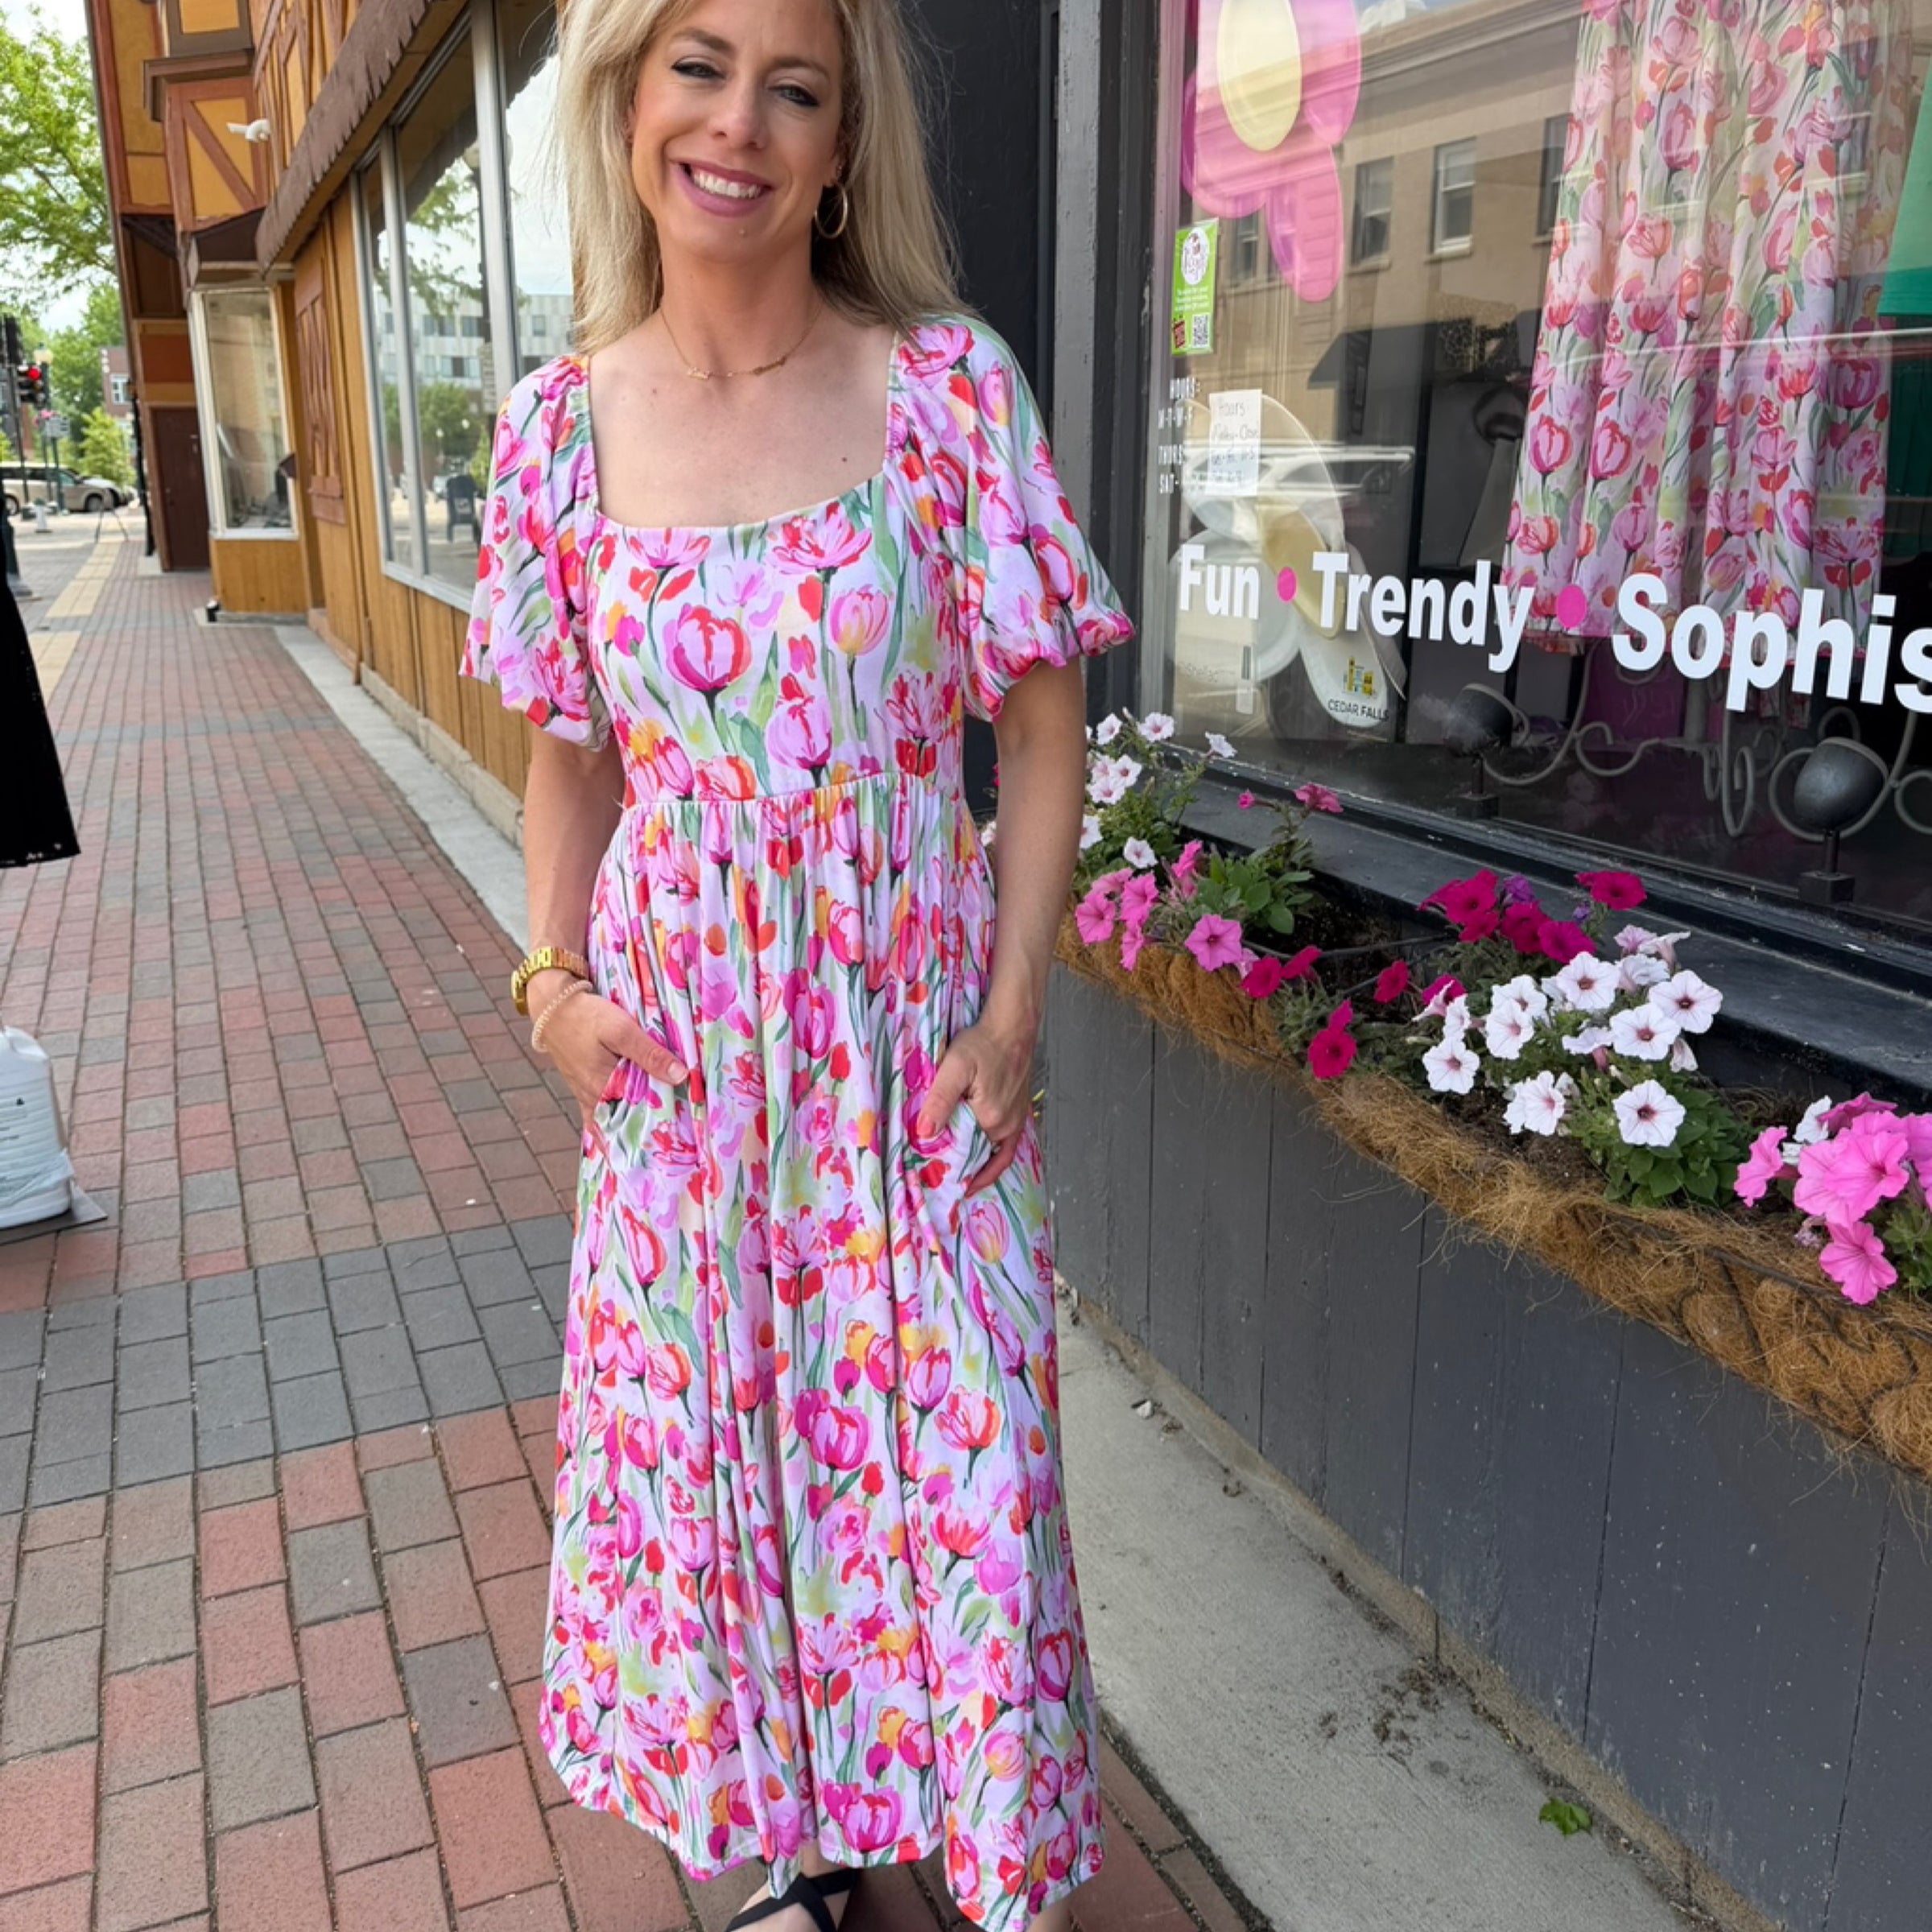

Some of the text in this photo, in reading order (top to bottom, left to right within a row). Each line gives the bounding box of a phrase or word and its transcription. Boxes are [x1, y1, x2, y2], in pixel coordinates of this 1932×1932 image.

[1179, 543, 1932, 714] Fun Trendy Sophis
[1327, 698, 1389, 722] CEDAR FALLS
